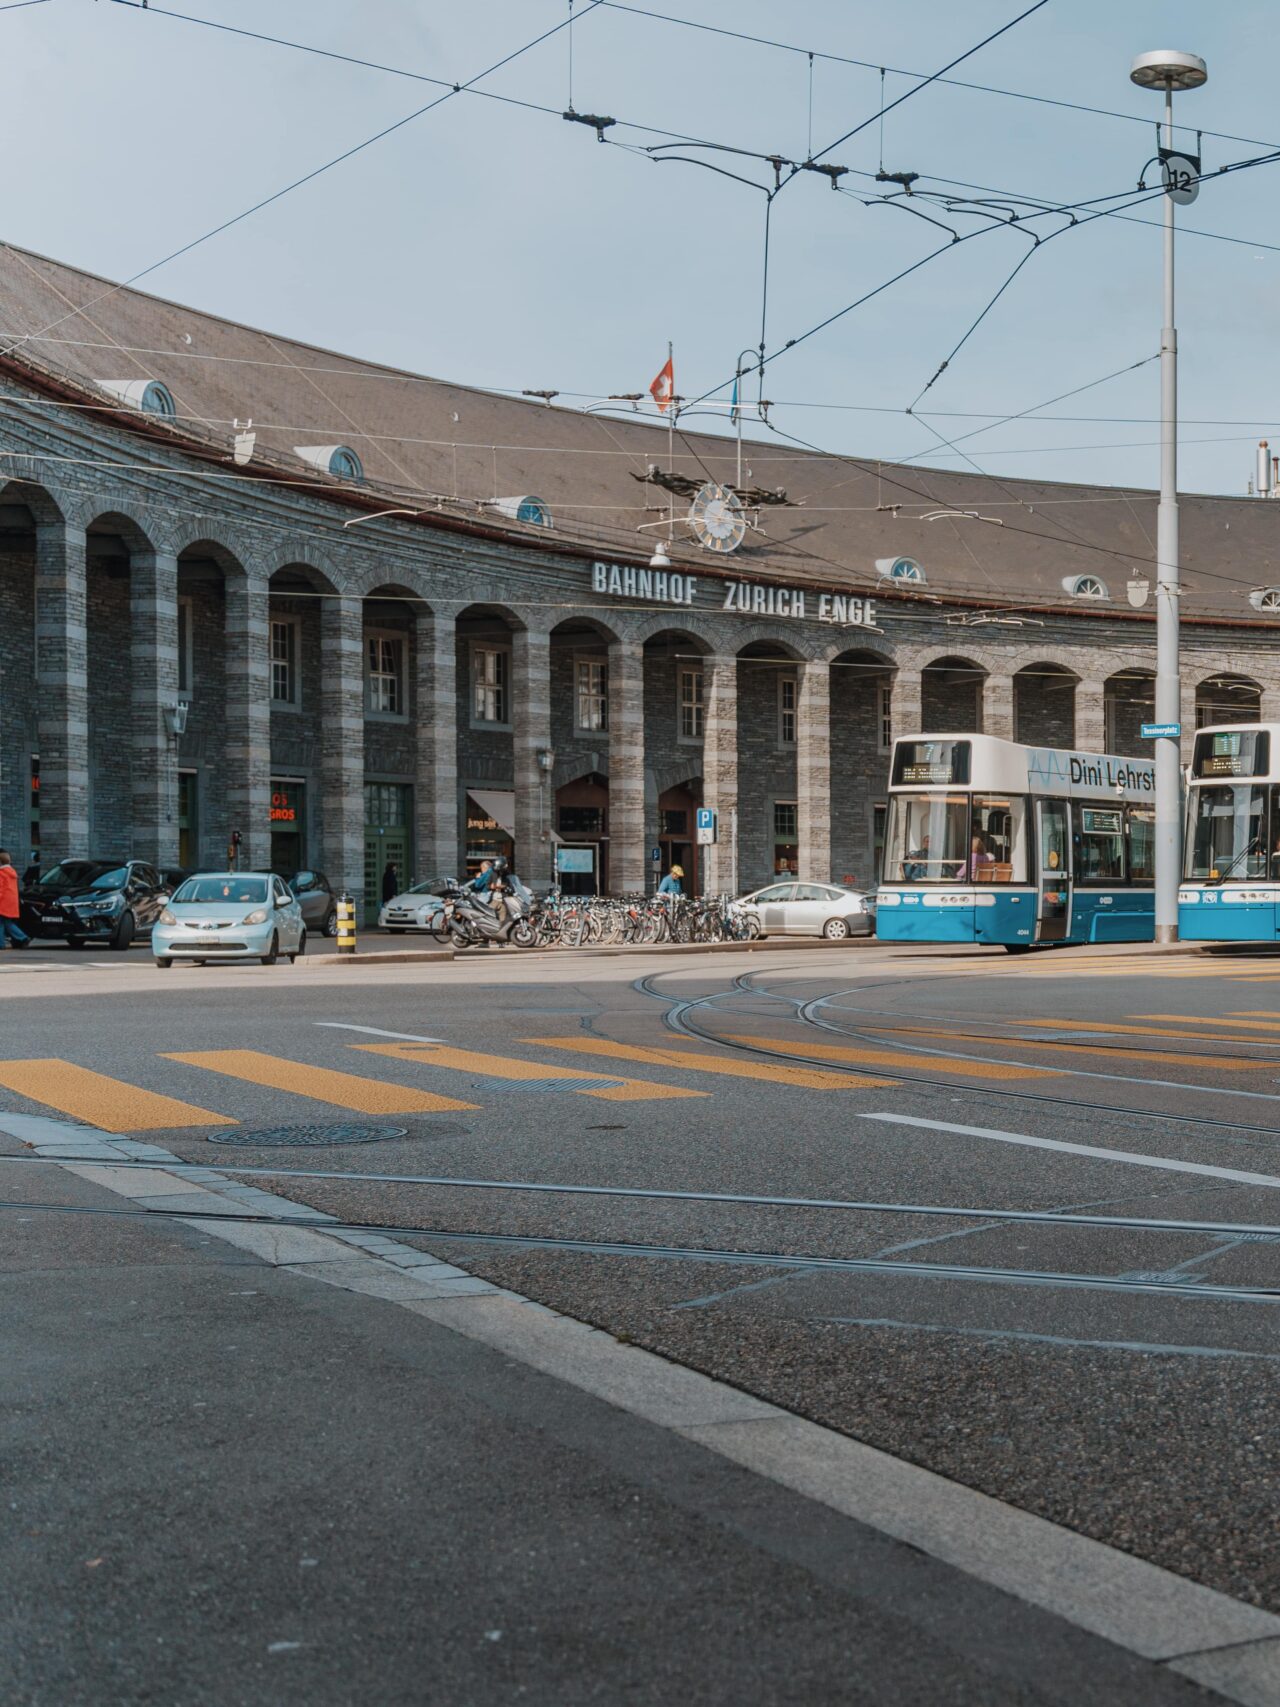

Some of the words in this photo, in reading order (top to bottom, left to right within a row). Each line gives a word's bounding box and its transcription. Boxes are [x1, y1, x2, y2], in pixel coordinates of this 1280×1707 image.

[1169, 169, 1192, 193] 12
[592, 562, 697, 605] BAHNHOF
[723, 580, 805, 618] ZÜRICH
[819, 594, 877, 626] ENGE
[1070, 758, 1102, 786] Dini
[701, 811, 710, 827] P
